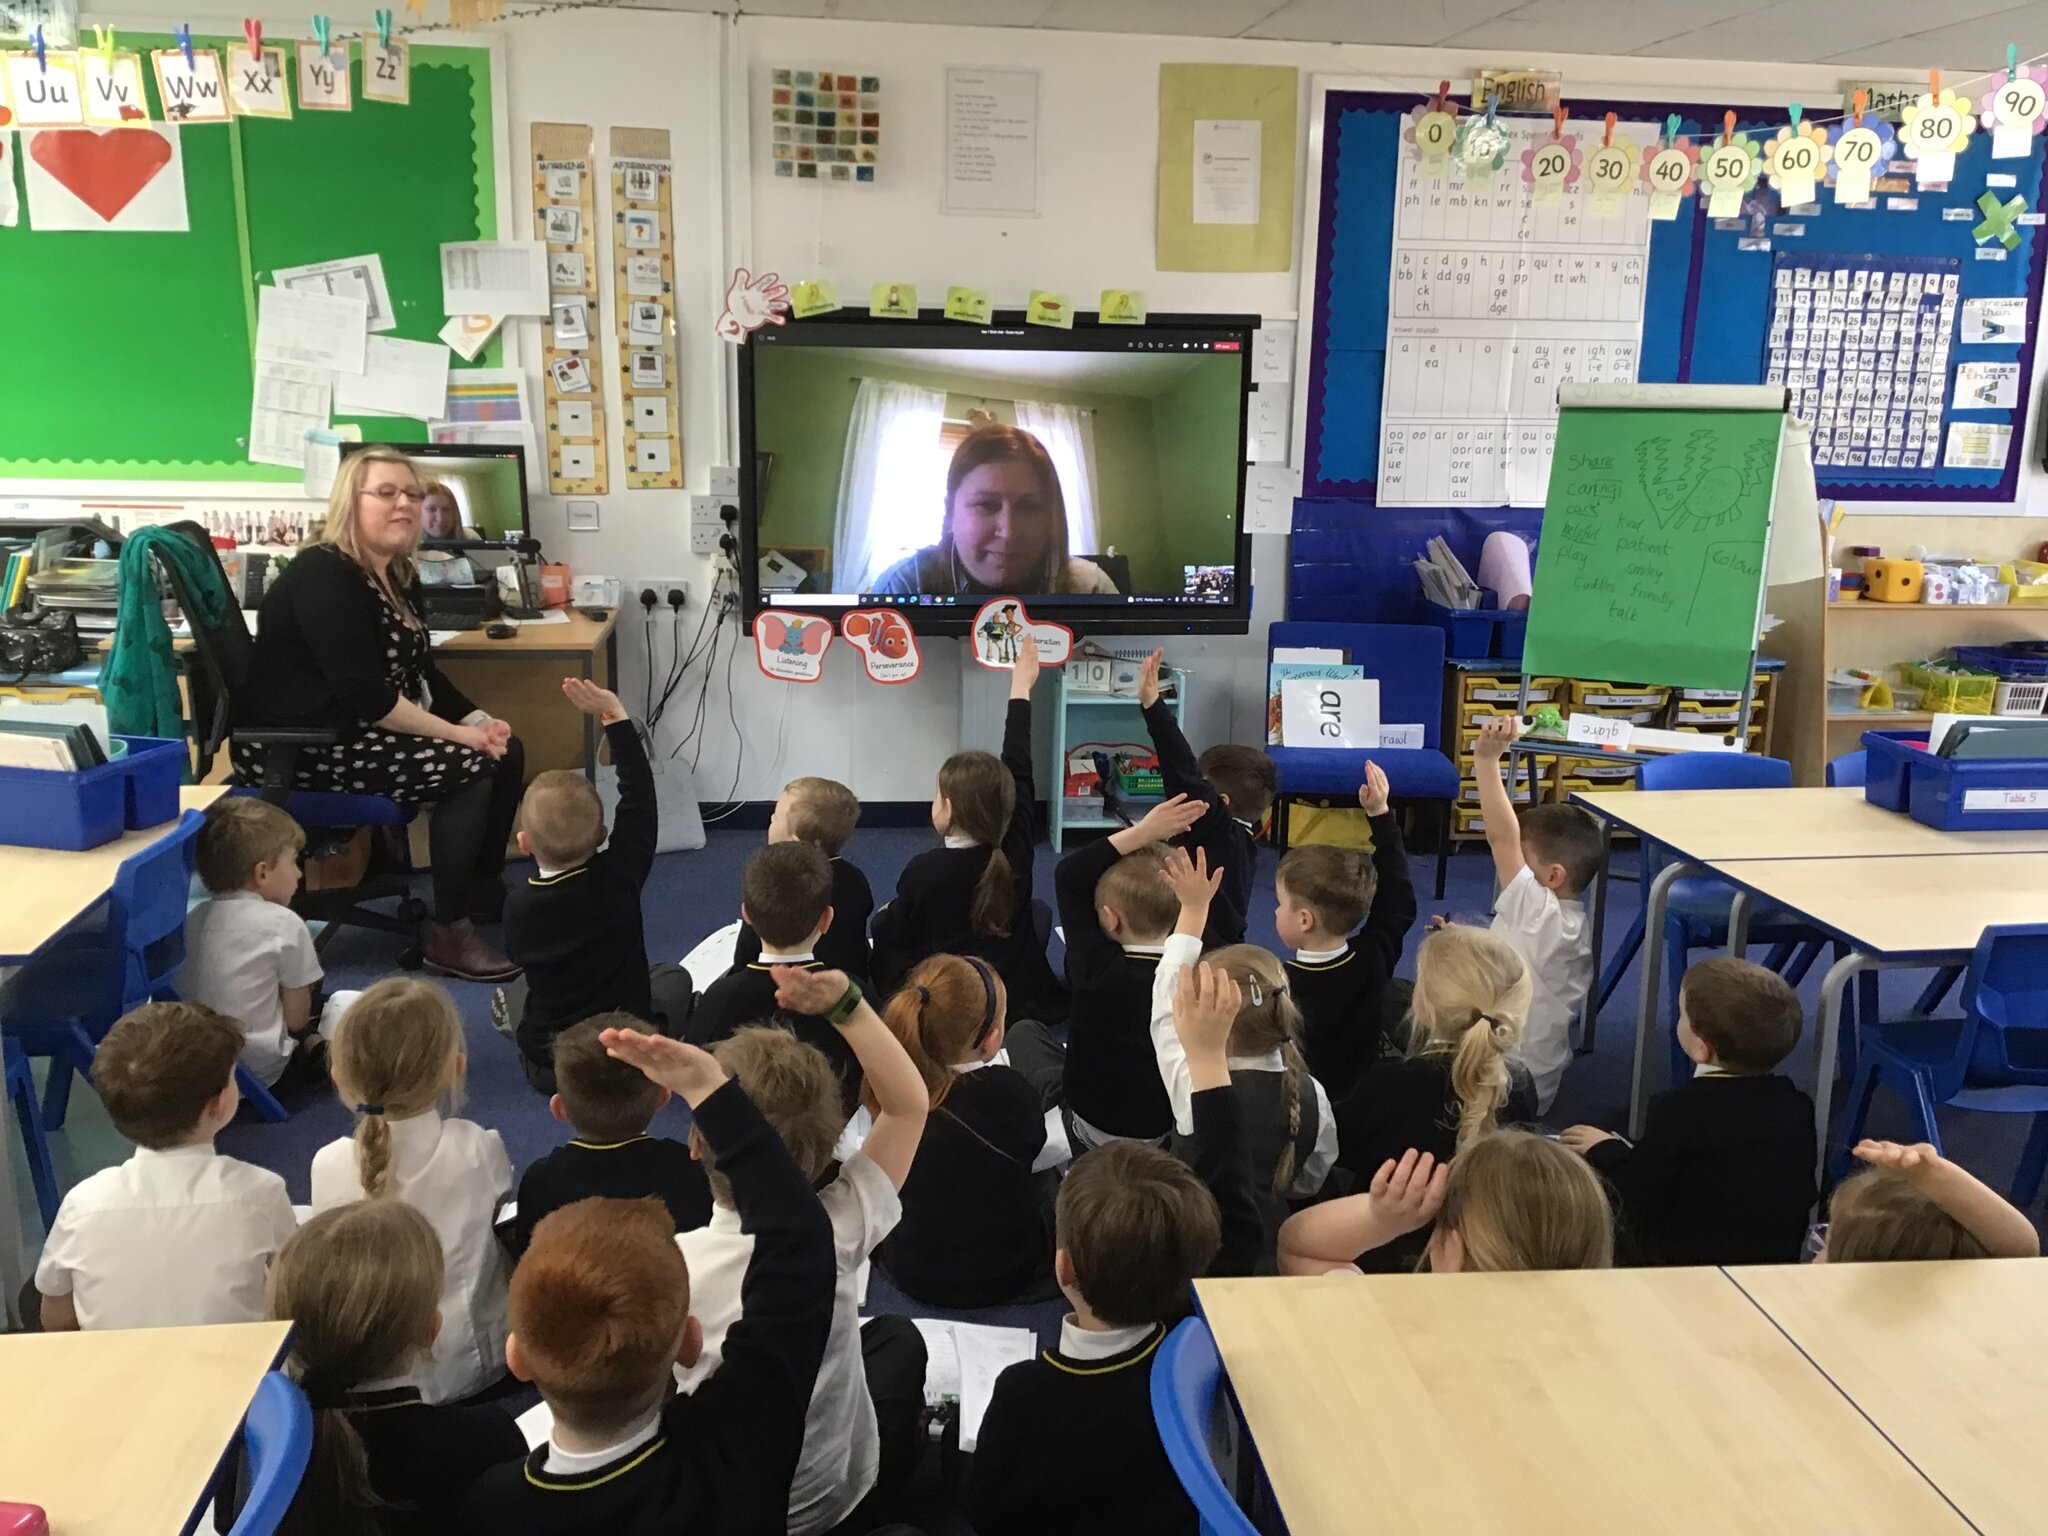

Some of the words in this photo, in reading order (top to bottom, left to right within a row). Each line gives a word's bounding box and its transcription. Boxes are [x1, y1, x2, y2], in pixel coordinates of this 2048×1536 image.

[375, 57, 396, 81] Zz
[244, 70, 273, 94] Xx
[310, 64, 335, 94] Yy
[26, 79, 68, 104] Uu
[96, 77, 128, 102] Vv
[166, 76, 218, 98] Ww
[1481, 77, 1545, 104] English
[1853, 87, 1919, 112] aths
[2005, 91, 2036, 116] 90
[1428, 124, 1442, 143] 0
[1920, 118, 1952, 139] 80
[1843, 141, 1873, 162] 70
[538, 161, 585, 170] MORNING
[1782, 148, 1812, 170] 60
[612, 161, 671, 172] AFTERNOON
[1538, 156, 1565, 177] 20
[1596, 158, 1623, 180] 30
[1656, 161, 1684, 182] 40
[1714, 158, 1744, 178] 50
[1500, 182, 1510, 192] rr
[1404, 196, 1419, 208] ph
[1430, 195, 1440, 206] le
[1450, 196, 1467, 206] mb
[1474, 196, 1488, 208] kn
[1497, 198, 1512, 208] wr
[1520, 200, 1532, 208] se
[1564, 216, 1576, 225] se
[1518, 229, 1530, 239] ce
[1404, 255, 1410, 264] b
[1423, 257, 1428, 265] c
[1442, 255, 1448, 266] d
[1461, 258, 1468, 269] g
[1480, 256, 1487, 266] h
[1519, 260, 1525, 270] p
[1534, 260, 1548, 271] qu
[1575, 260, 1583, 268] w
[1595, 260, 1600, 268] x
[1611, 261, 1618, 272] y
[1626, 258, 1638, 270] ch
[1399, 270, 1412, 281] bb
[1422, 270, 1428, 281] k
[1436, 271, 1450, 282] dd
[1456, 274, 1470, 284] gg
[1498, 274, 1505, 284] g
[1514, 274, 1528, 286] pp
[1554, 274, 1563, 284] tt
[1570, 273, 1586, 284] wh
[1624, 274, 1639, 285] tch
[1945, 279, 1956, 288] 10
[1418, 285, 1430, 296] ck
[1494, 289, 1508, 300] ge
[1416, 301, 1430, 312] ch
[1490, 302, 1508, 314] dge
[1780, 294, 1789, 302] 11
[1851, 297, 1860, 305] 15
[1871, 296, 1880, 304] 16
[1908, 297, 1917, 306] 18
[1944, 298, 1954, 307] 20
[1777, 314, 1788, 322] 21
[1832, 317, 1841, 325] 24
[1849, 317, 1859, 325] 25
[1772, 335, 1783, 343] 31
[1864, 335, 1874, 343] 36
[1902, 336, 1913, 345] 38
[1402, 344, 1408, 352] a
[1430, 344, 1436, 352] e
[1485, 346, 1492, 354] o
[1536, 346, 1549, 358] ay
[1563, 346, 1576, 355] ee
[1588, 346, 1605, 358] igh
[1615, 348, 1632, 356] ow
[1425, 360, 1438, 368] ea
[1565, 362, 1572, 372] y
[1534, 376, 1545, 384] ai
[1560, 376, 1574, 384] ea
[1589, 376, 1599, 384] ie
[1770, 373, 1781, 381] 51
[1806, 374, 1816, 382] 53
[1917, 377, 1927, 385] 59
[1806, 393, 1817, 402] 63
[1877, 394, 1888, 402] 67
[1913, 394, 1924, 403] 69
[1857, 414, 1867, 423] 76
[1390, 431, 1404, 440] oo
[1412, 431, 1426, 440] oo
[1434, 431, 1446, 440] ar
[1457, 431, 1469, 440] or
[1477, 430, 1492, 440] air
[1503, 431, 1512, 440] ir
[1522, 432, 1536, 440] ou
[1854, 431, 1865, 440] 86
[1928, 434, 1938, 443] 90
[1386, 443, 1404, 454] u-e
[1452, 446, 1470, 455] oor
[1475, 446, 1493, 455] are
[1500, 446, 1512, 454] ur
[1520, 446, 1537, 454] ow
[1388, 460, 1401, 469] ue
[1452, 460, 1470, 469] ore
[1500, 460, 1512, 469] er
[1852, 453, 1862, 461] 96
[1887, 454, 1897, 463] 98
[1386, 475, 1401, 483] ew
[1452, 475, 1468, 483] aw
[1452, 490, 1466, 498] au
[1616, 536, 1672, 556] patient
[1556, 545, 1588, 571] play
[1610, 600, 1638, 622] talk
[777, 656, 808, 670] Listening
[1072, 665, 1079, 679] 1
[1092, 665, 1104, 680] 0
[1320, 690, 1341, 738] are
[1582, 723, 1619, 736] glare
[1379, 731, 1407, 745] rawl
[2003, 793, 2026, 803] Table
[2029, 793, 2036, 802] 5
